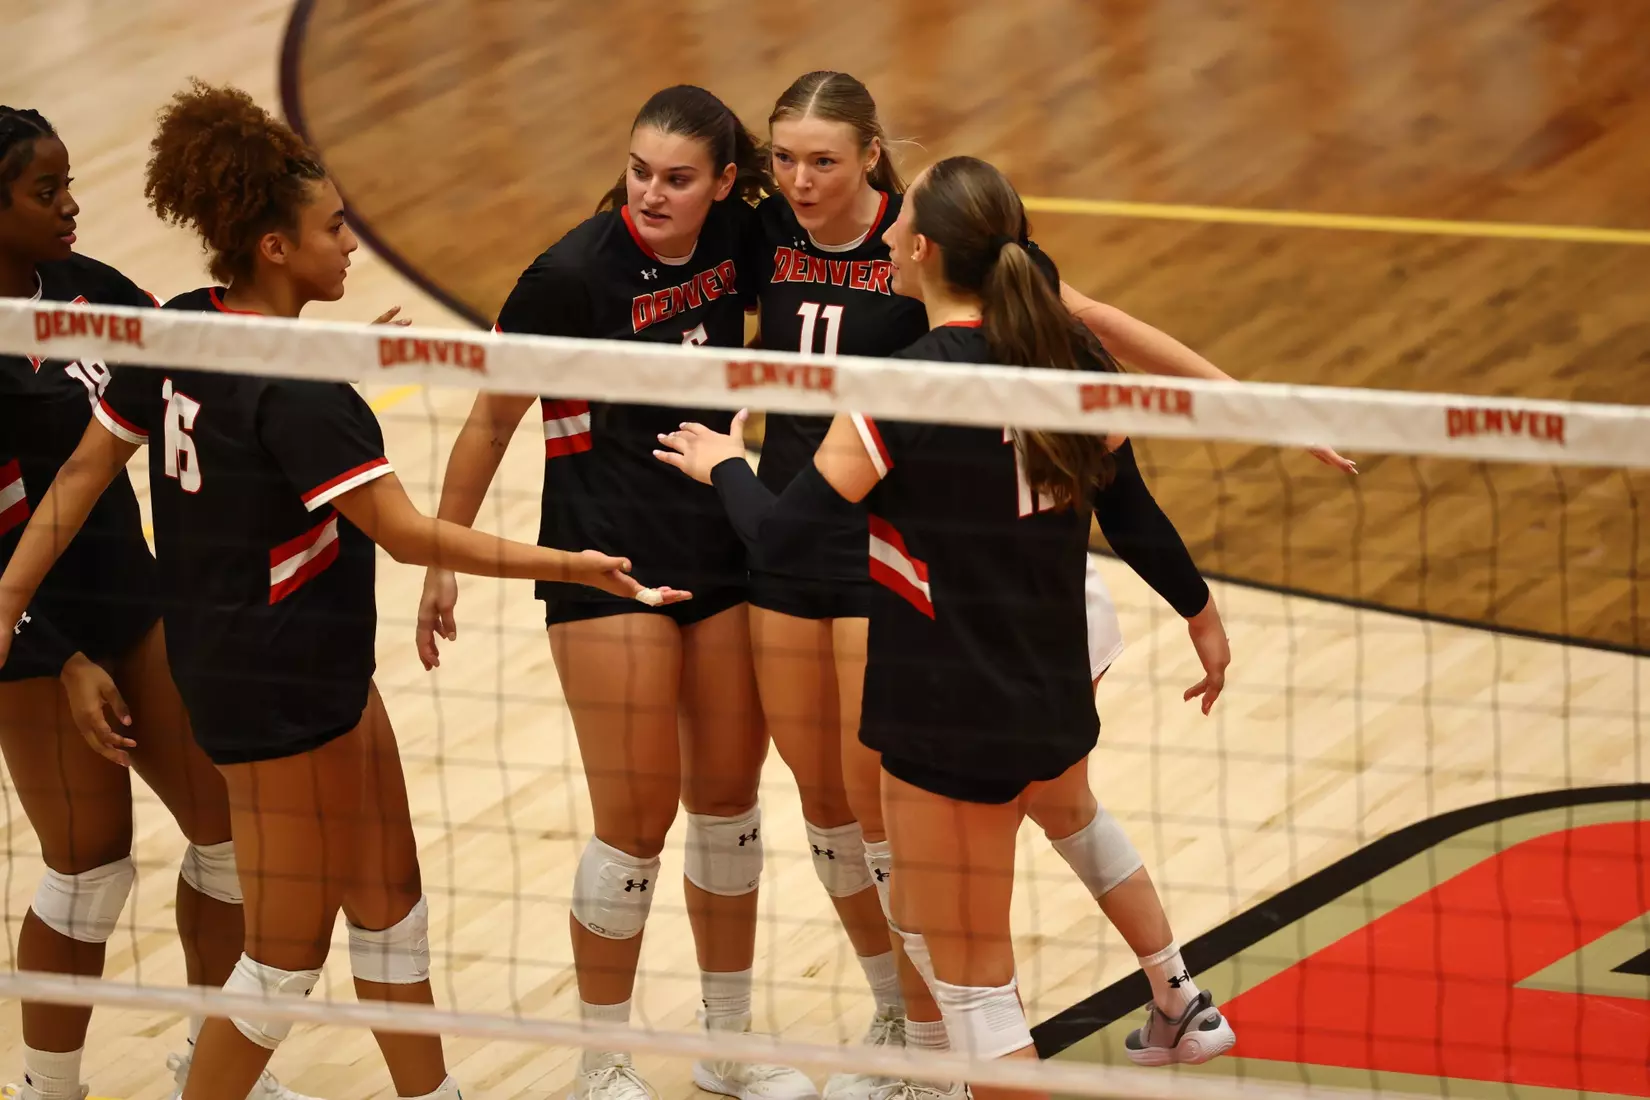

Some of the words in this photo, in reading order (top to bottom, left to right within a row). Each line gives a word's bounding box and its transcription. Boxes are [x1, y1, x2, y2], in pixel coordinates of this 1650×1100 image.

[770, 246, 893, 296] DENVER
[631, 258, 738, 334] DENVER
[34, 310, 144, 349] DENVER
[797, 301, 844, 357] 11
[378, 336, 488, 376] DENVER
[726, 360, 837, 397] DENVER
[1078, 383, 1196, 421] DENVER
[1445, 407, 1566, 445] DENVER
